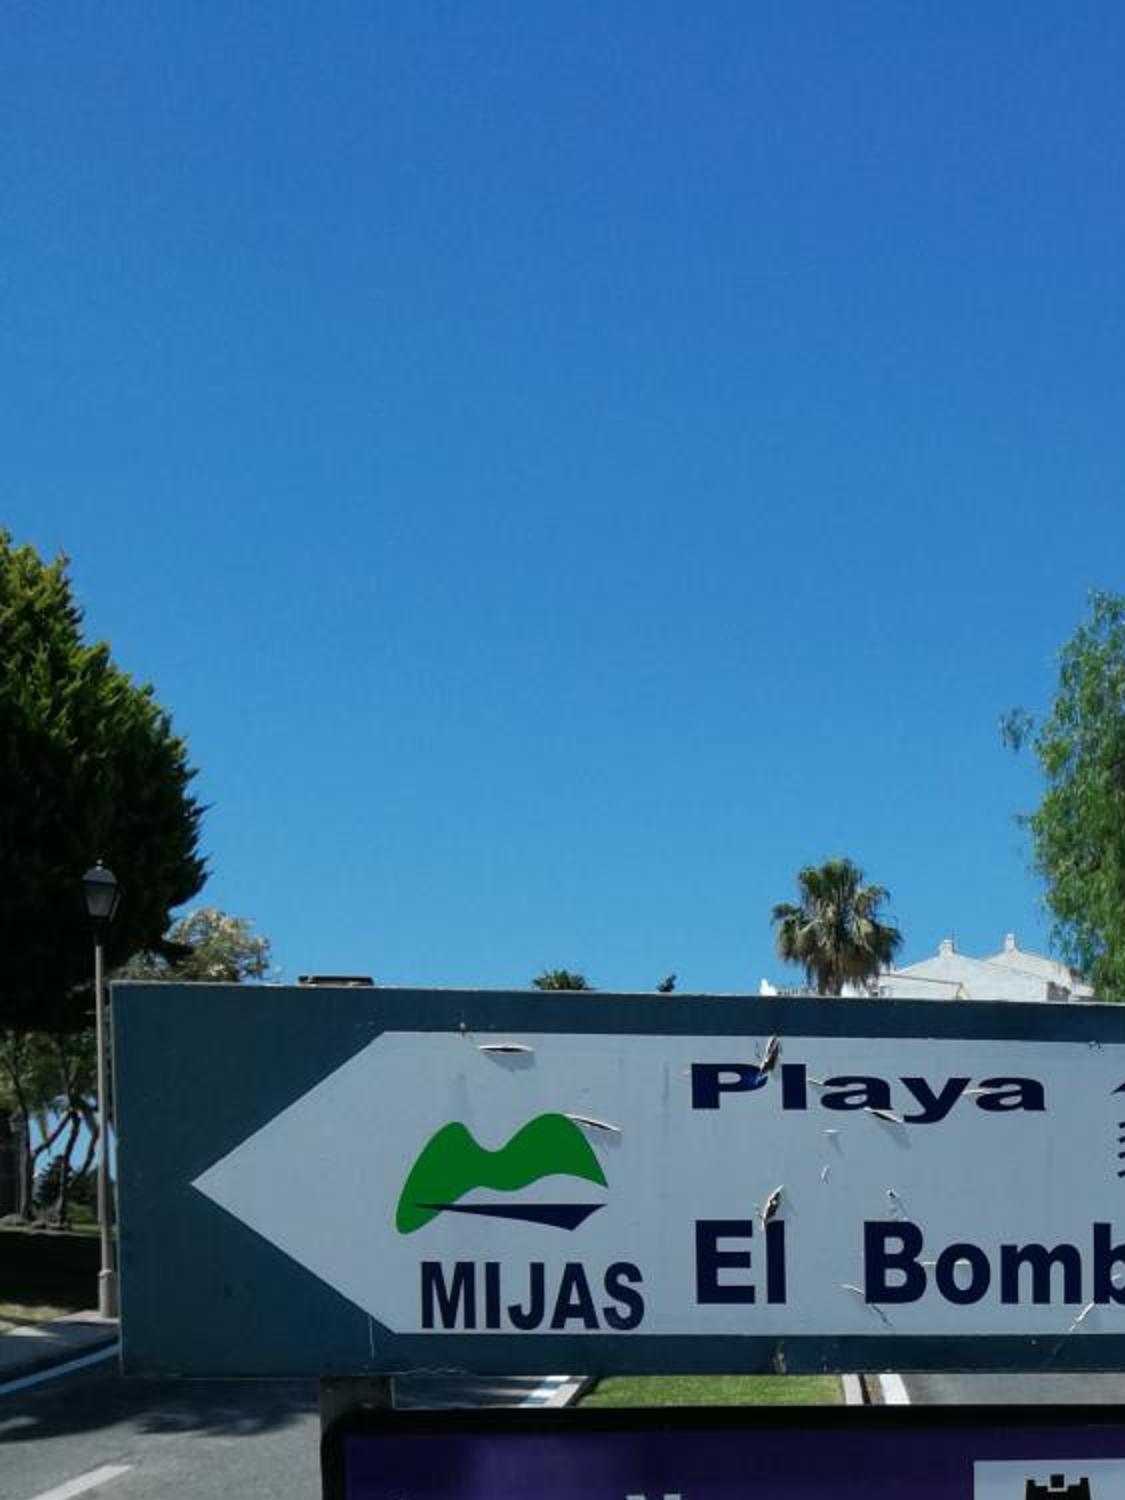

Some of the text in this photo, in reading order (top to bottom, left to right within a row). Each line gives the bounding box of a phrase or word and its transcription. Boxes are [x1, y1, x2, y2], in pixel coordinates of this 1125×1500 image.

[691, 1062, 1047, 1125] Playa
[420, 1260, 645, 1331] MIJAS
[695, 1219, 787, 1305] El
